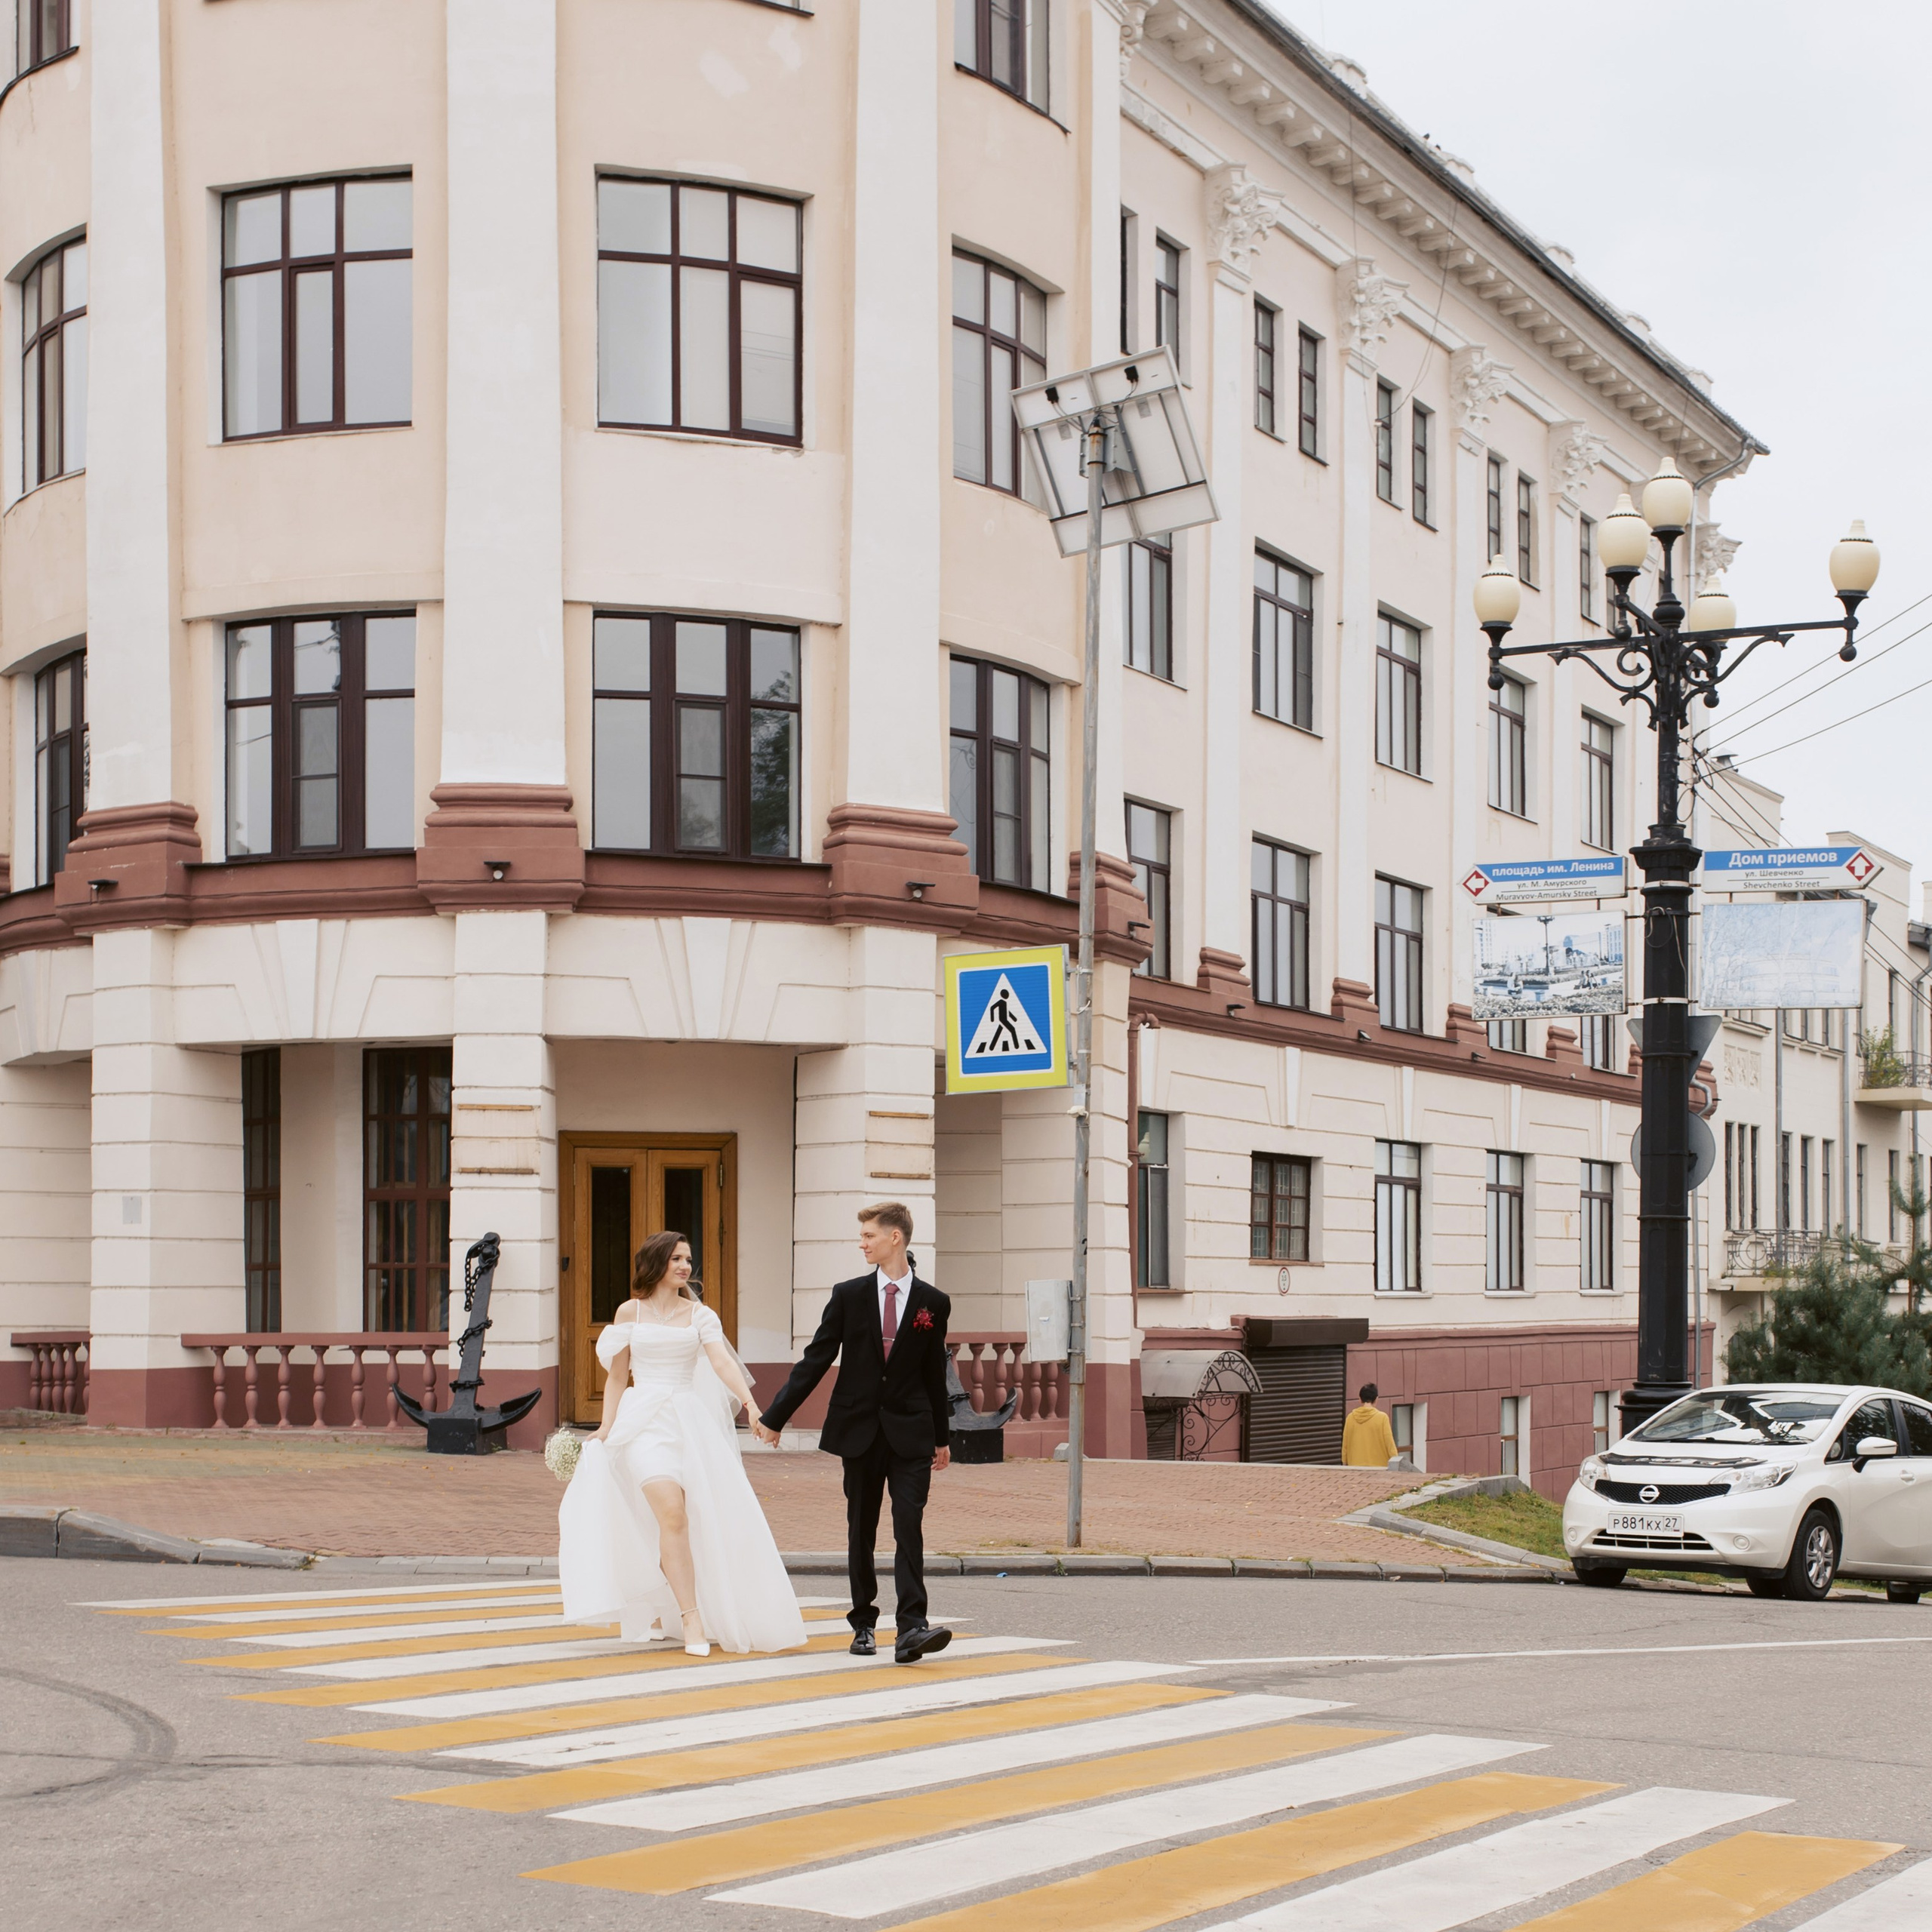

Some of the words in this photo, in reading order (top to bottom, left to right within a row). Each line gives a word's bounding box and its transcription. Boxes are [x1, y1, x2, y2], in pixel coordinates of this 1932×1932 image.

[1728, 852, 1764, 868] Дом
[1767, 852, 1838, 866] приемов
[1492, 866, 1545, 877] площадь
[1547, 865, 1567, 873] им.
[1570, 862, 1614, 872] Ленина
[1543, 879, 1587, 888] Амурского
[1496, 891, 1571, 900] Muravyov-Amursky
[1665, 1518, 1677, 1527] 27
